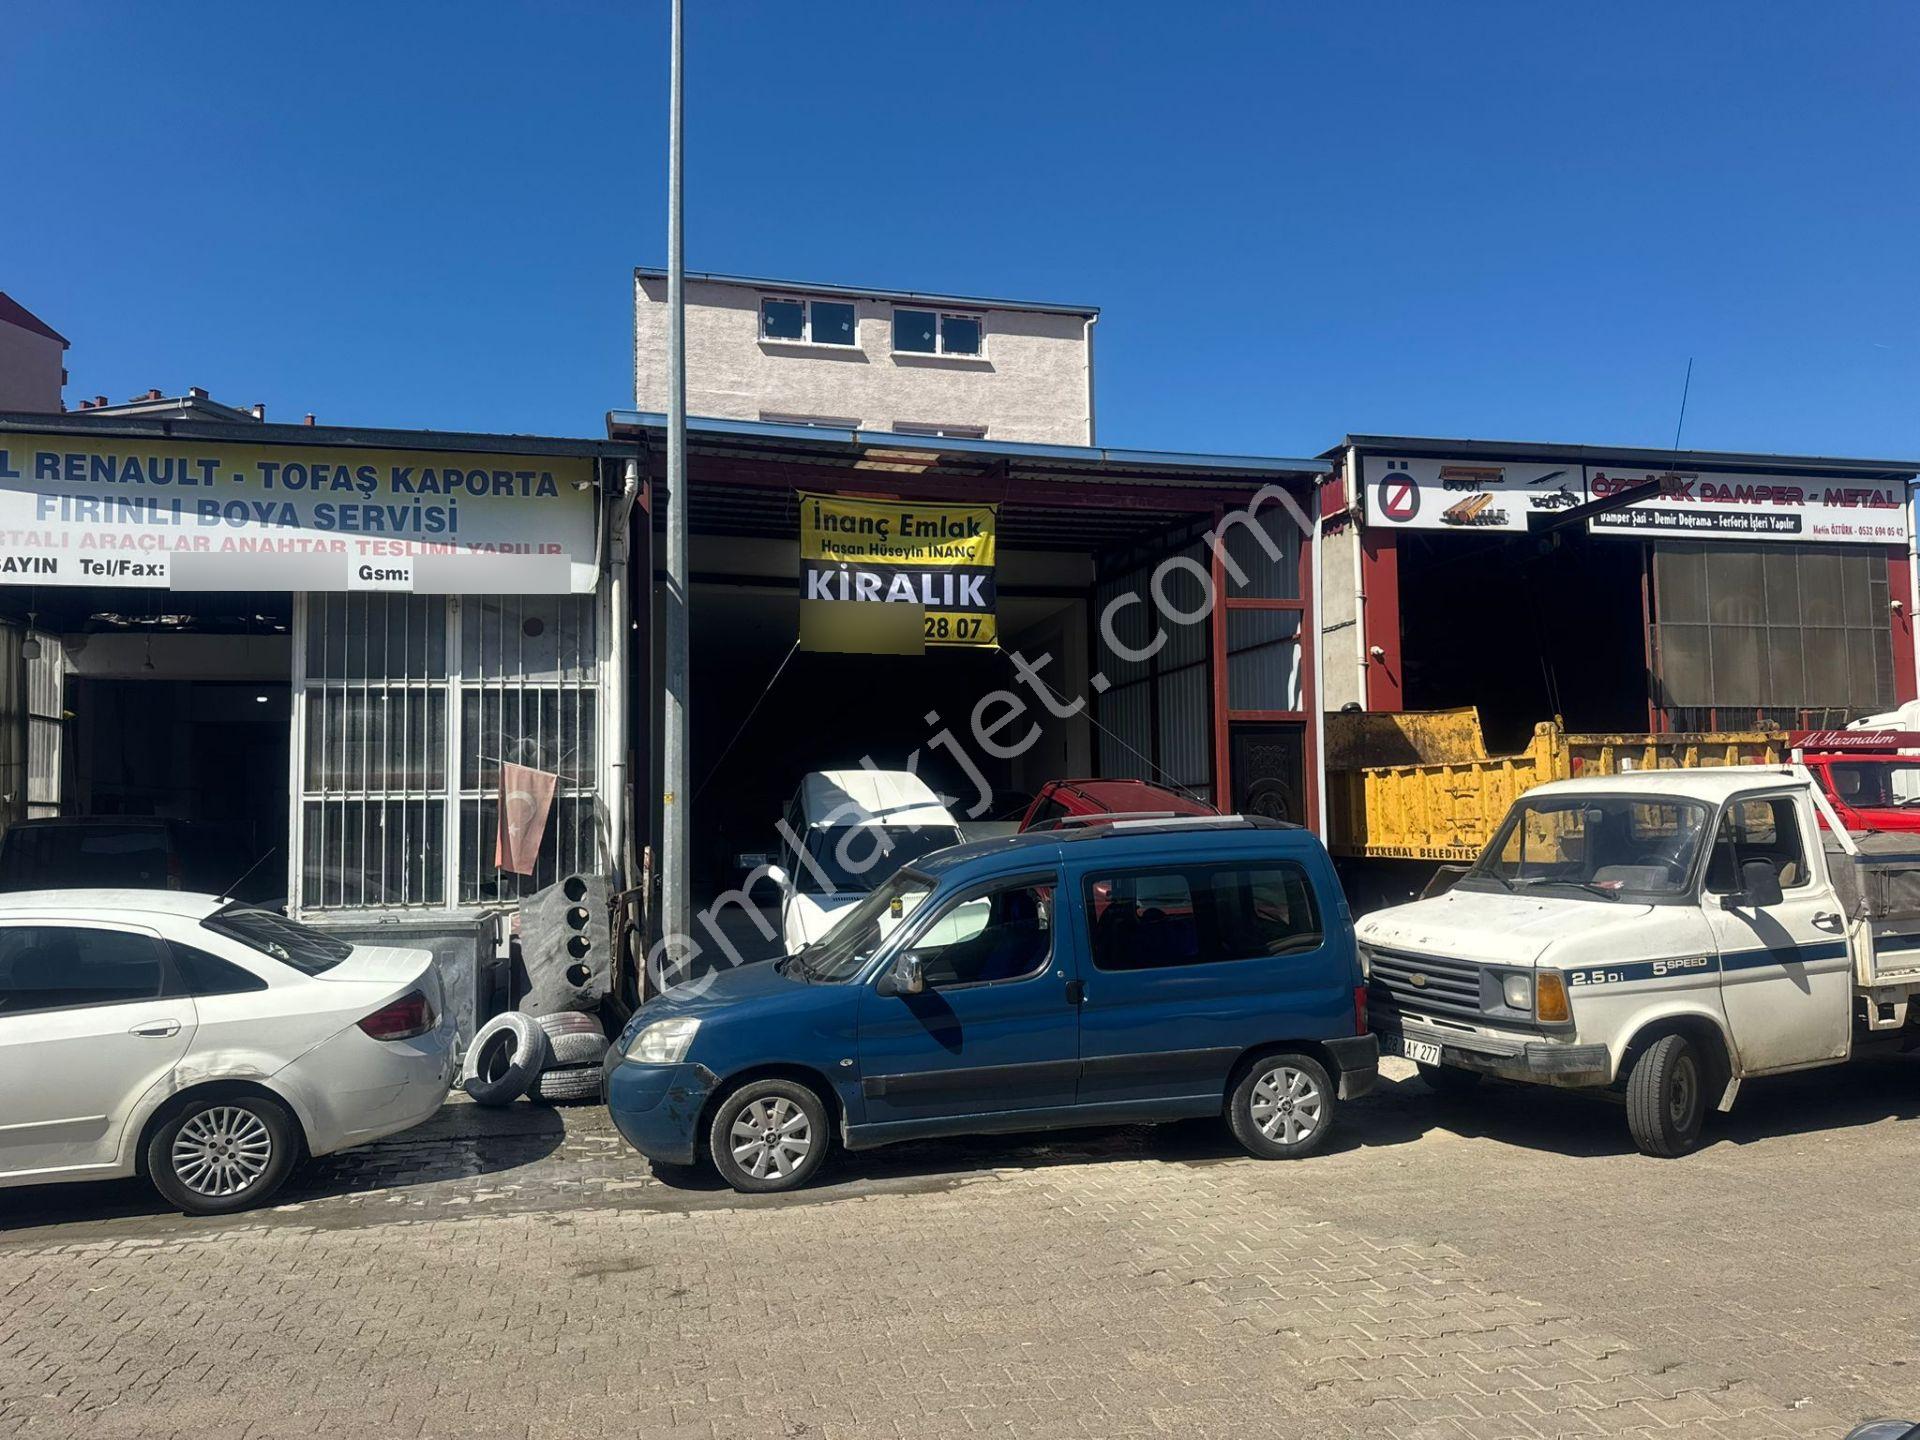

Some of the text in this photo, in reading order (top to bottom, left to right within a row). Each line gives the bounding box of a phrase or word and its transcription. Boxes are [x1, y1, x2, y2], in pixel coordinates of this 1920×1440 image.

[35, 451, 221, 487] RENAULT
[257, 461, 379, 499] TOFAŞ
[391, 466, 559, 498] KAPORTA
[1591, 472, 1697, 503] ÖZK
[1700, 482, 1806, 506] DAMPER
[1823, 487, 1900, 510] METAL
[36, 493, 458, 534] FIRINLI BOYA SERVİSİ
[813, 501, 982, 541] İnanç Emlak
[1632, 510, 1647, 526] Şasi
[1654, 511, 1677, 525] Demir
[1678, 511, 1712, 528] Doğrama
[1750, 513, 1768, 531] İşleri
[1769, 516, 1795, 530] Yapılır
[79, 532, 211, 553] ARAÇLAR
[221, 535, 347, 552] ANAHTAR
[355, 536, 458, 556] TESLİMİ
[821, 539, 976, 562] Hasan Hüseyin İNANÇ
[0, 556, 410, 581] AYIN Tel/Fax: Gsm:
[807, 562, 987, 607] KİRALIK
[925, 618, 983, 639] 28 07
[1420, 847, 1482, 860] BELEDİYES
[1406, 1041, 1419, 1058] AY
[1420, 1044, 1438, 1062] 277
